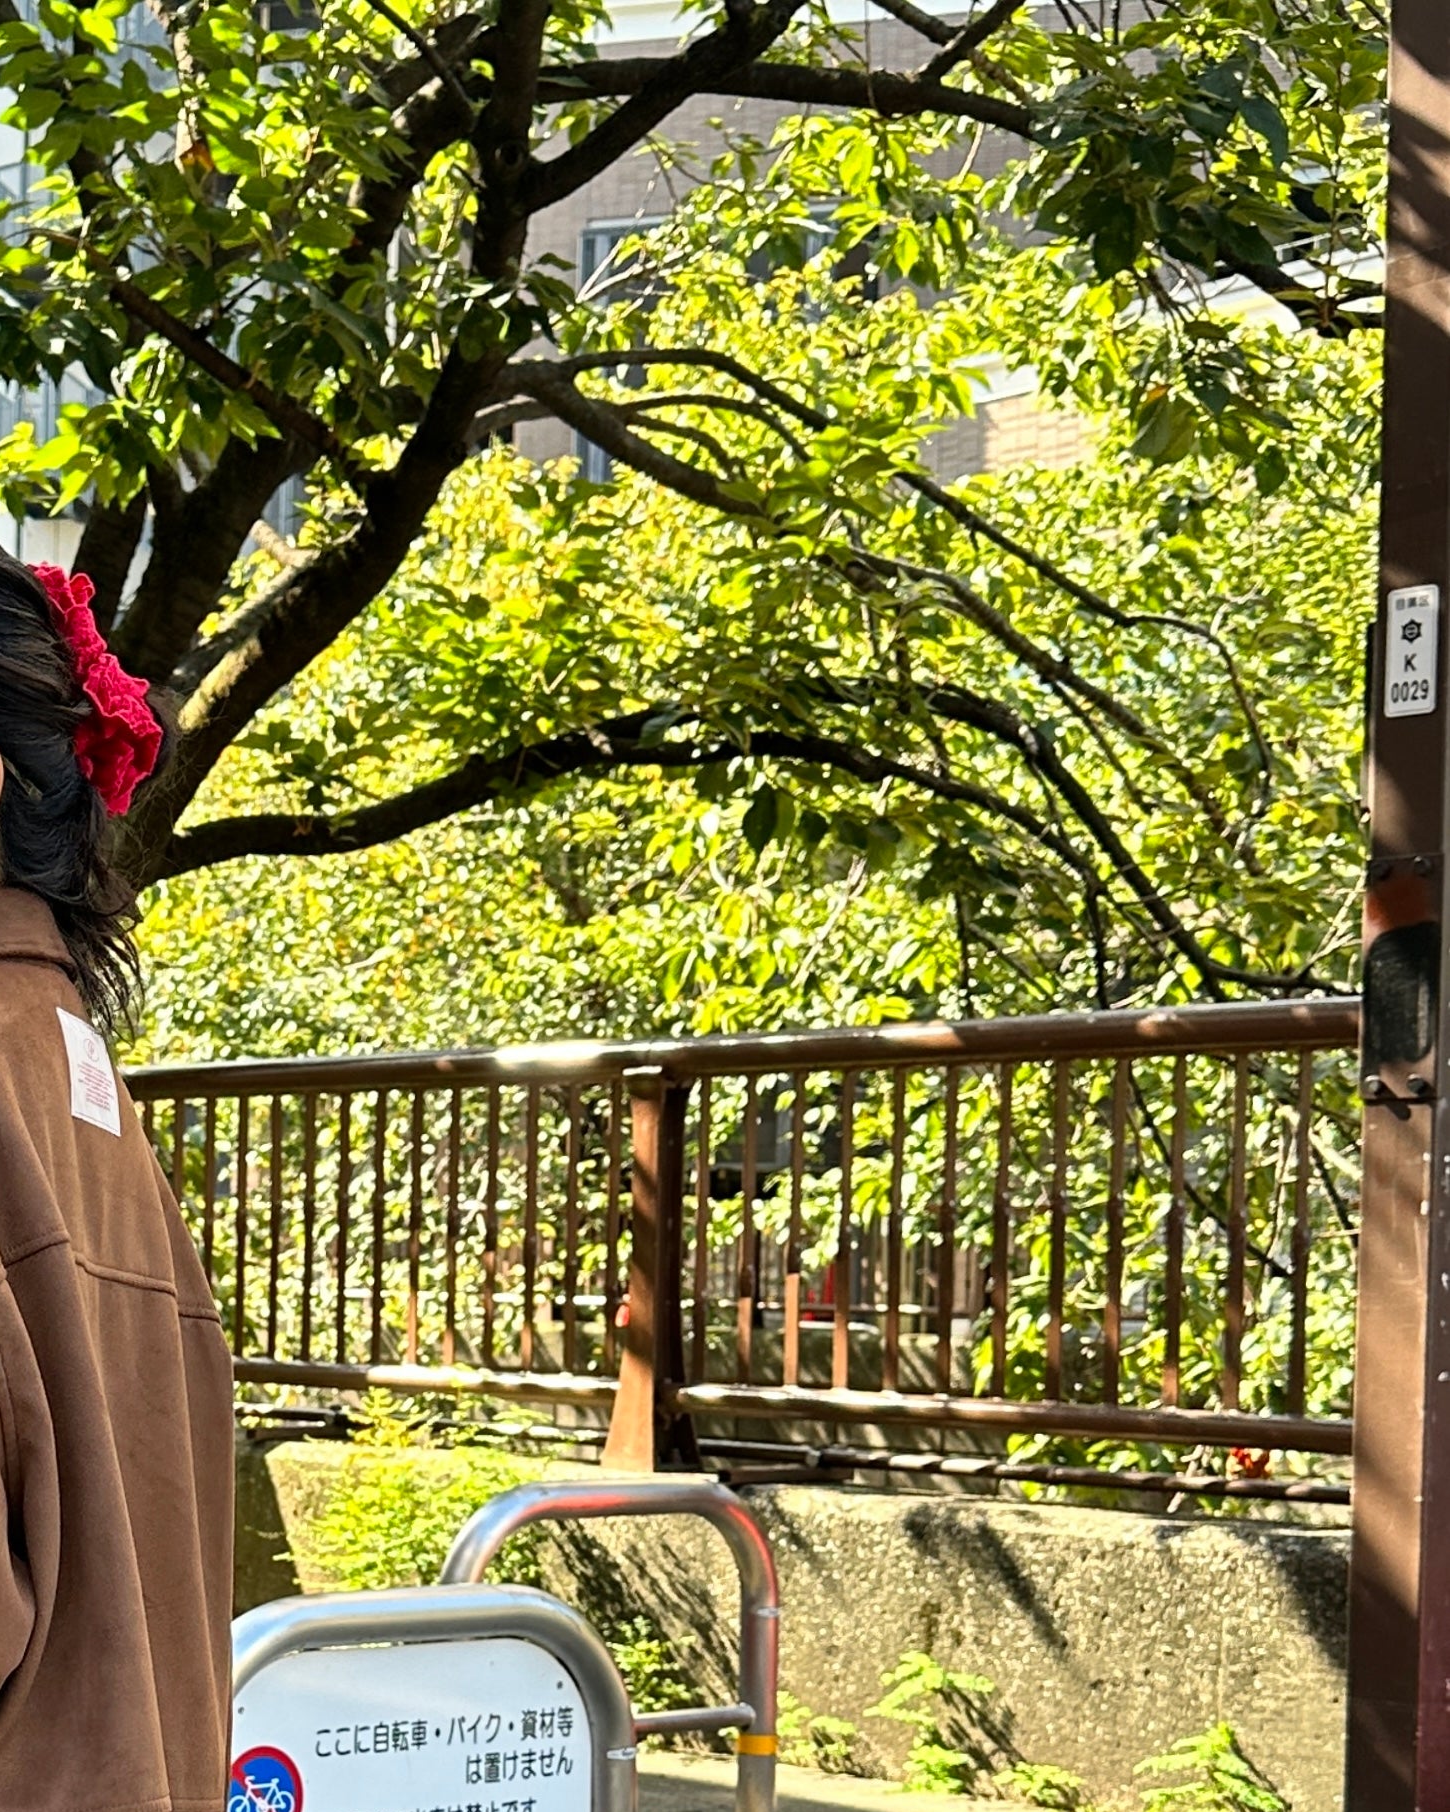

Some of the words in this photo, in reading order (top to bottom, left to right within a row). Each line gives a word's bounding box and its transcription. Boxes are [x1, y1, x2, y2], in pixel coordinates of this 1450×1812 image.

[1404, 653, 1417, 673] K
[1390, 679, 1429, 703] 0029
[315, 1707, 574, 1757] ここに自転車・バイク・資材等
[466, 1746, 573, 1784] は置けません
